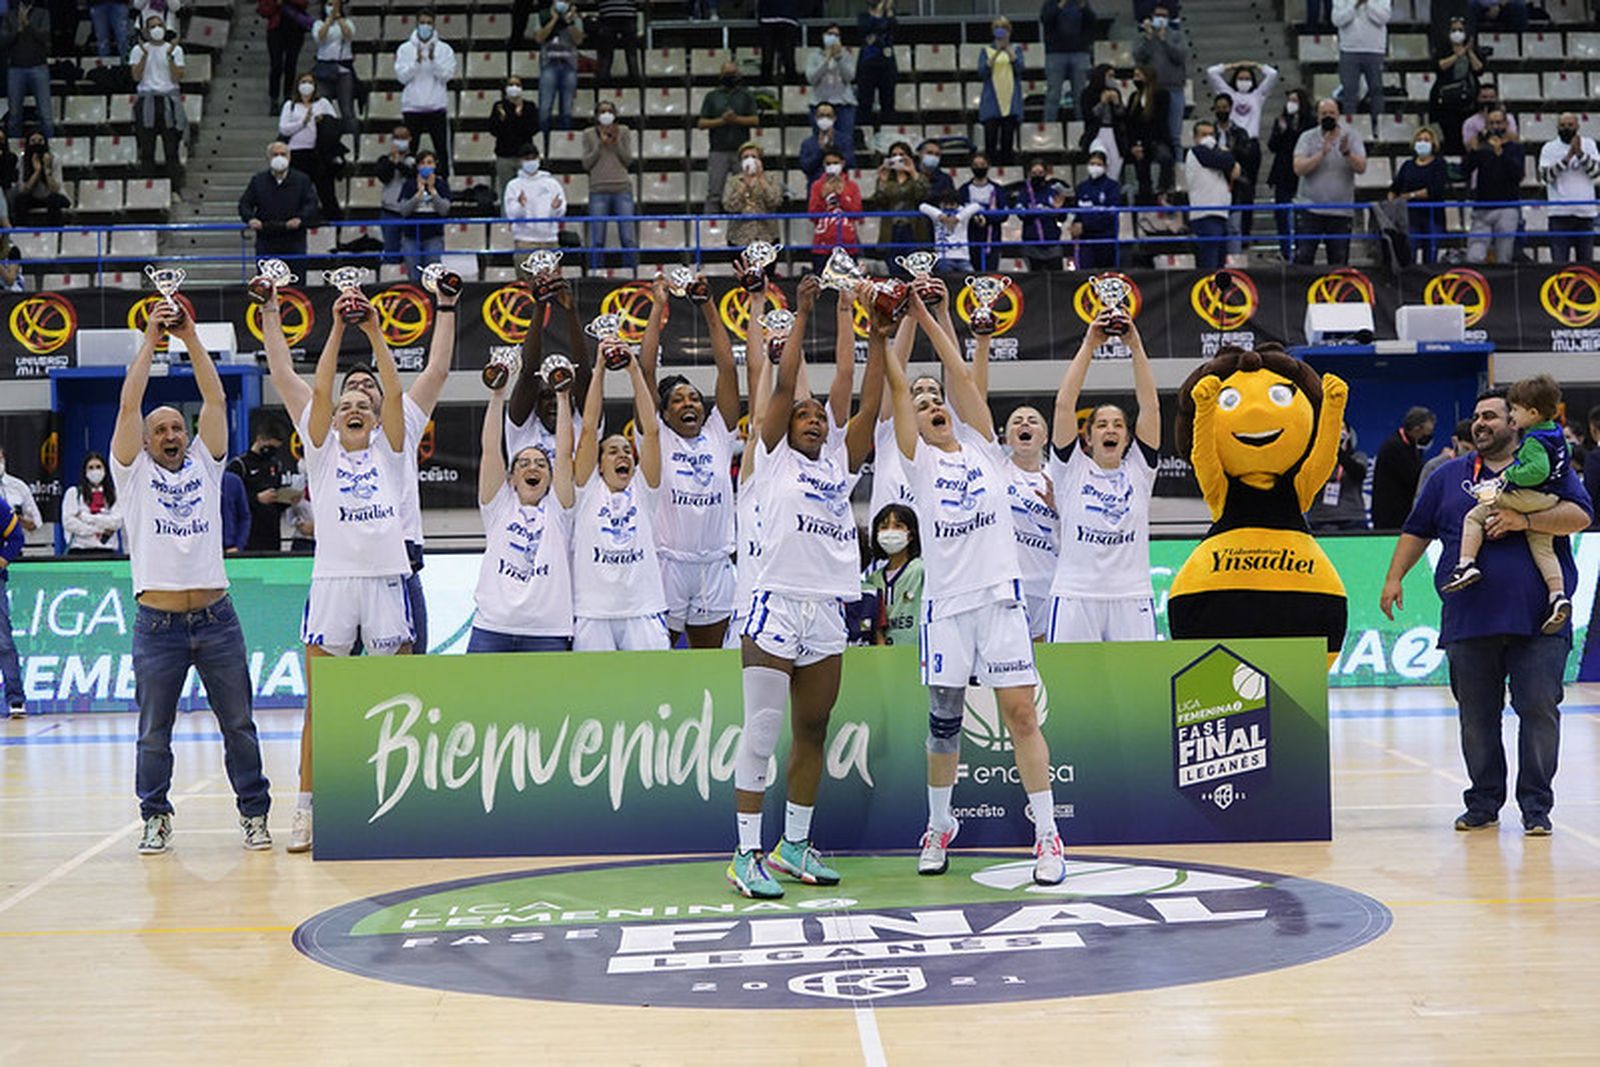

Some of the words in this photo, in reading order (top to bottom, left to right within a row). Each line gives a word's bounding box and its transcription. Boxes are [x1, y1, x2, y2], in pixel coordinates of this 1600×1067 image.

[1210, 548, 1315, 575] Ynsadiet
[934, 653, 943, 673] 3
[1178, 718, 1226, 741] FASE
[828, 721, 875, 788] a
[1179, 724, 1266, 765] FINAL
[1186, 754, 1260, 781] LEGANÉS
[952, 803, 1006, 818] oncesto
[401, 902, 791, 929] FEMENINA
[408, 901, 562, 918] LIGA
[402, 928, 600, 949] FASE
[616, 896, 1268, 954] FINAL
